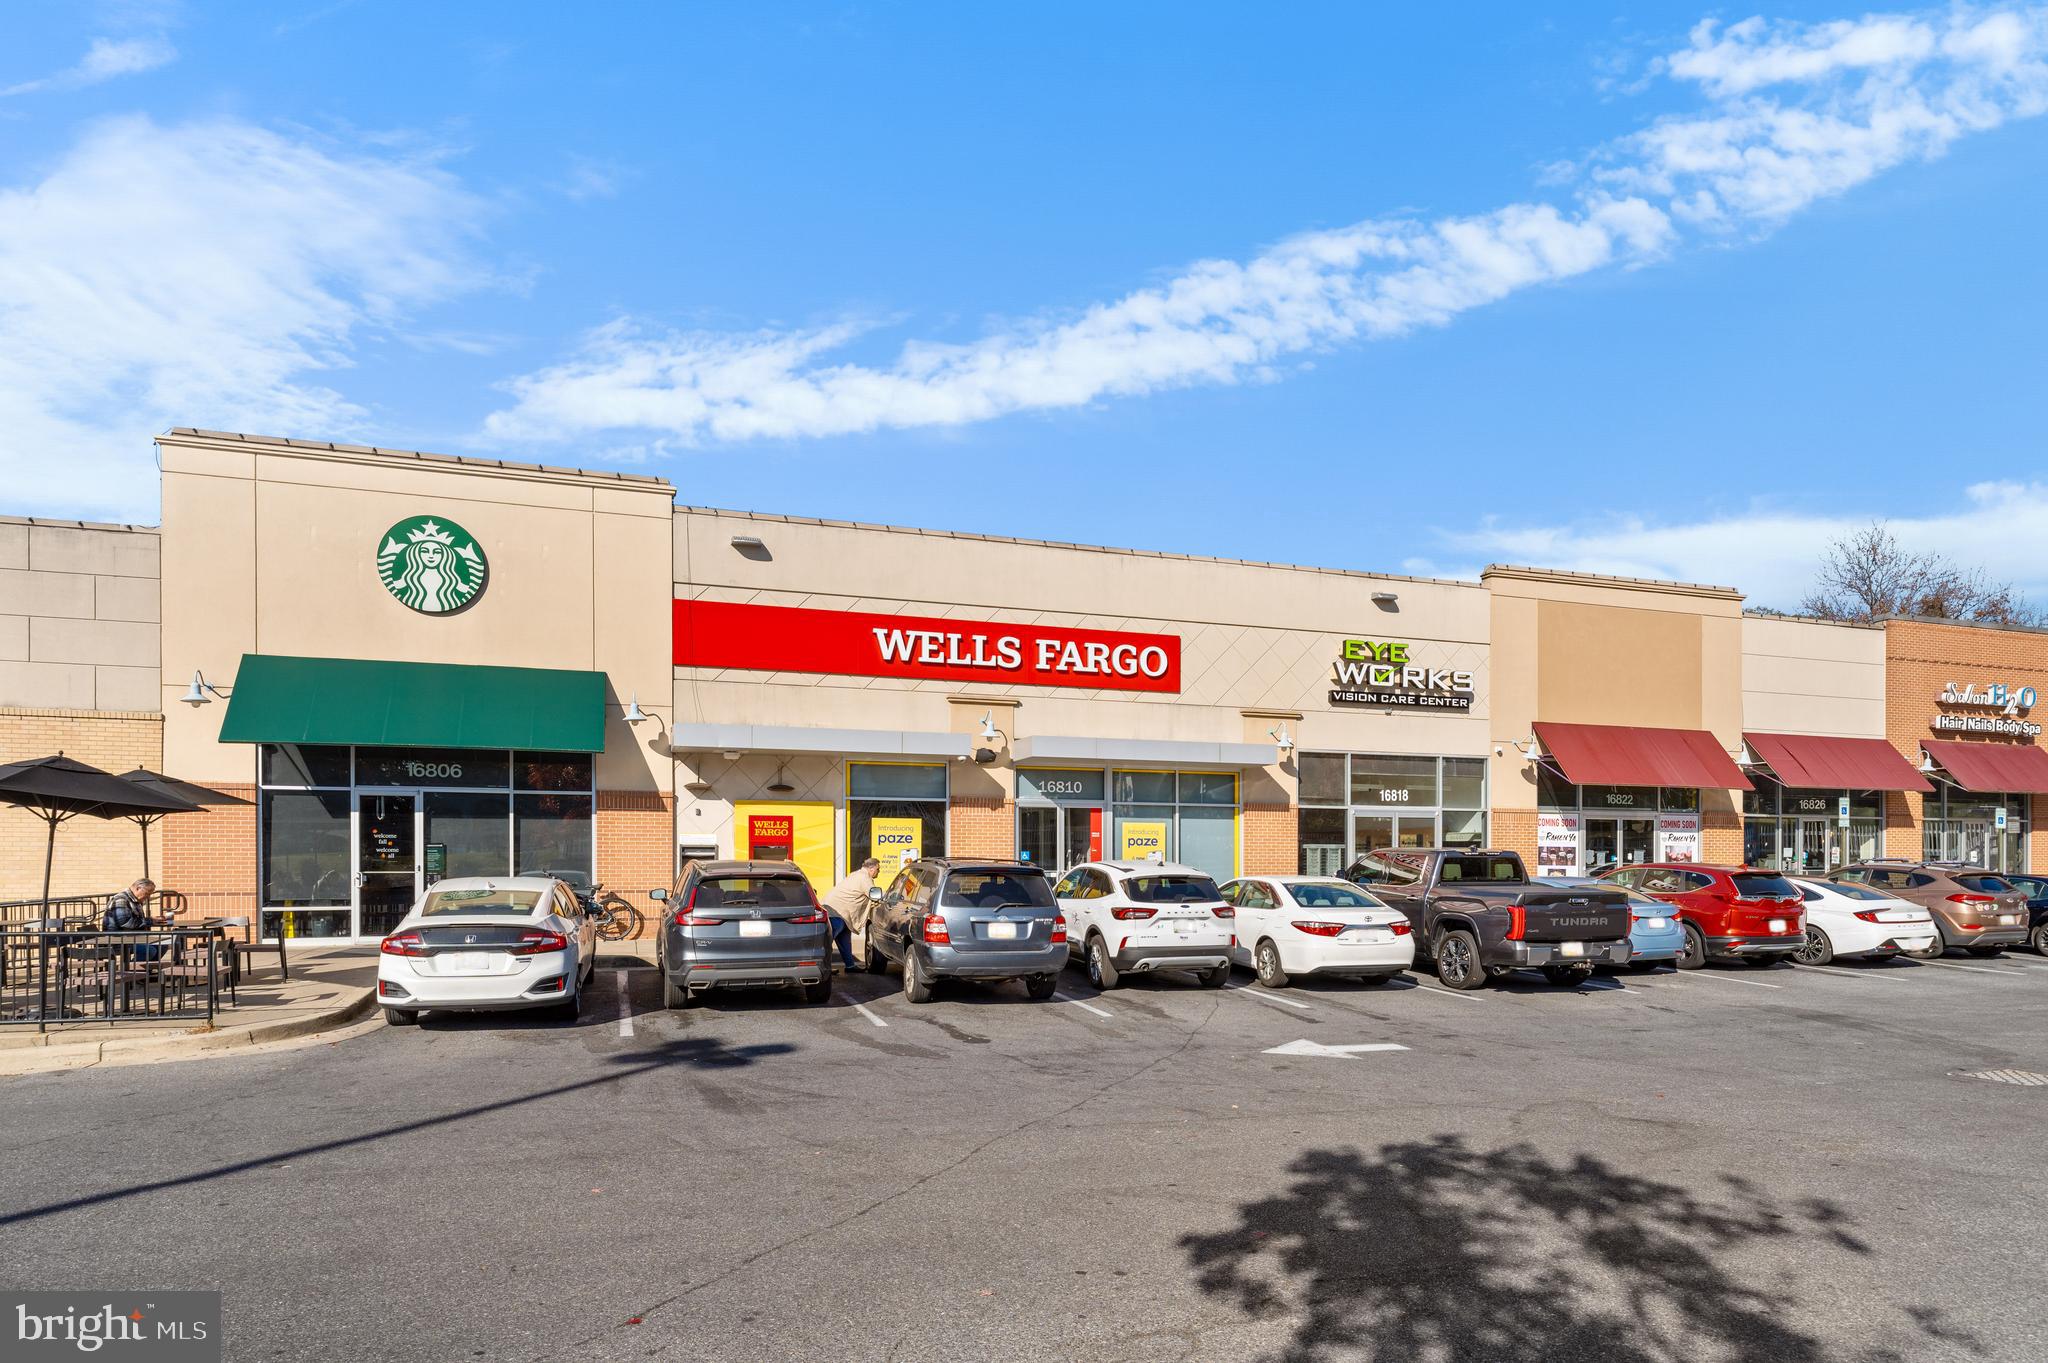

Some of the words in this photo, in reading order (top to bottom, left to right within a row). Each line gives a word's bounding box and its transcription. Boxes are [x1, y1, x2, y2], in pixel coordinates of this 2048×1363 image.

[872, 628, 1021, 669] WELLS
[1035, 638, 1168, 677] FARGO
[1344, 639, 1410, 664] EYE
[1334, 660, 1475, 692] WORKS
[1333, 691, 1377, 703] VISION
[1380, 694, 1416, 705] CARE
[1419, 696, 1469, 708] CENTER
[1941, 682, 1988, 705] Salon
[1941, 716, 1964, 729] Hair
[1966, 717, 1994, 731] Nails
[1995, 719, 2021, 735] Body
[2021, 721, 2041, 737] Spa
[407, 762, 463, 778] 16806
[1038, 780, 1083, 794] 16810
[1379, 789, 1409, 802] 16818
[1606, 794, 1634, 805] 16822
[1799, 799, 1826, 810] 16826
[753, 820, 790, 829] WELLS
[1538, 818, 1560, 828] COMING
[1560, 818, 1577, 828] SOON
[1660, 819, 1681, 829] COMING
[1681, 819, 1697, 829] SOON
[754, 828, 789, 837] FARGO
[878, 834, 913, 846] paze
[1127, 837, 1159, 848] paze
[1549, 917, 1609, 927] TUNDRA
